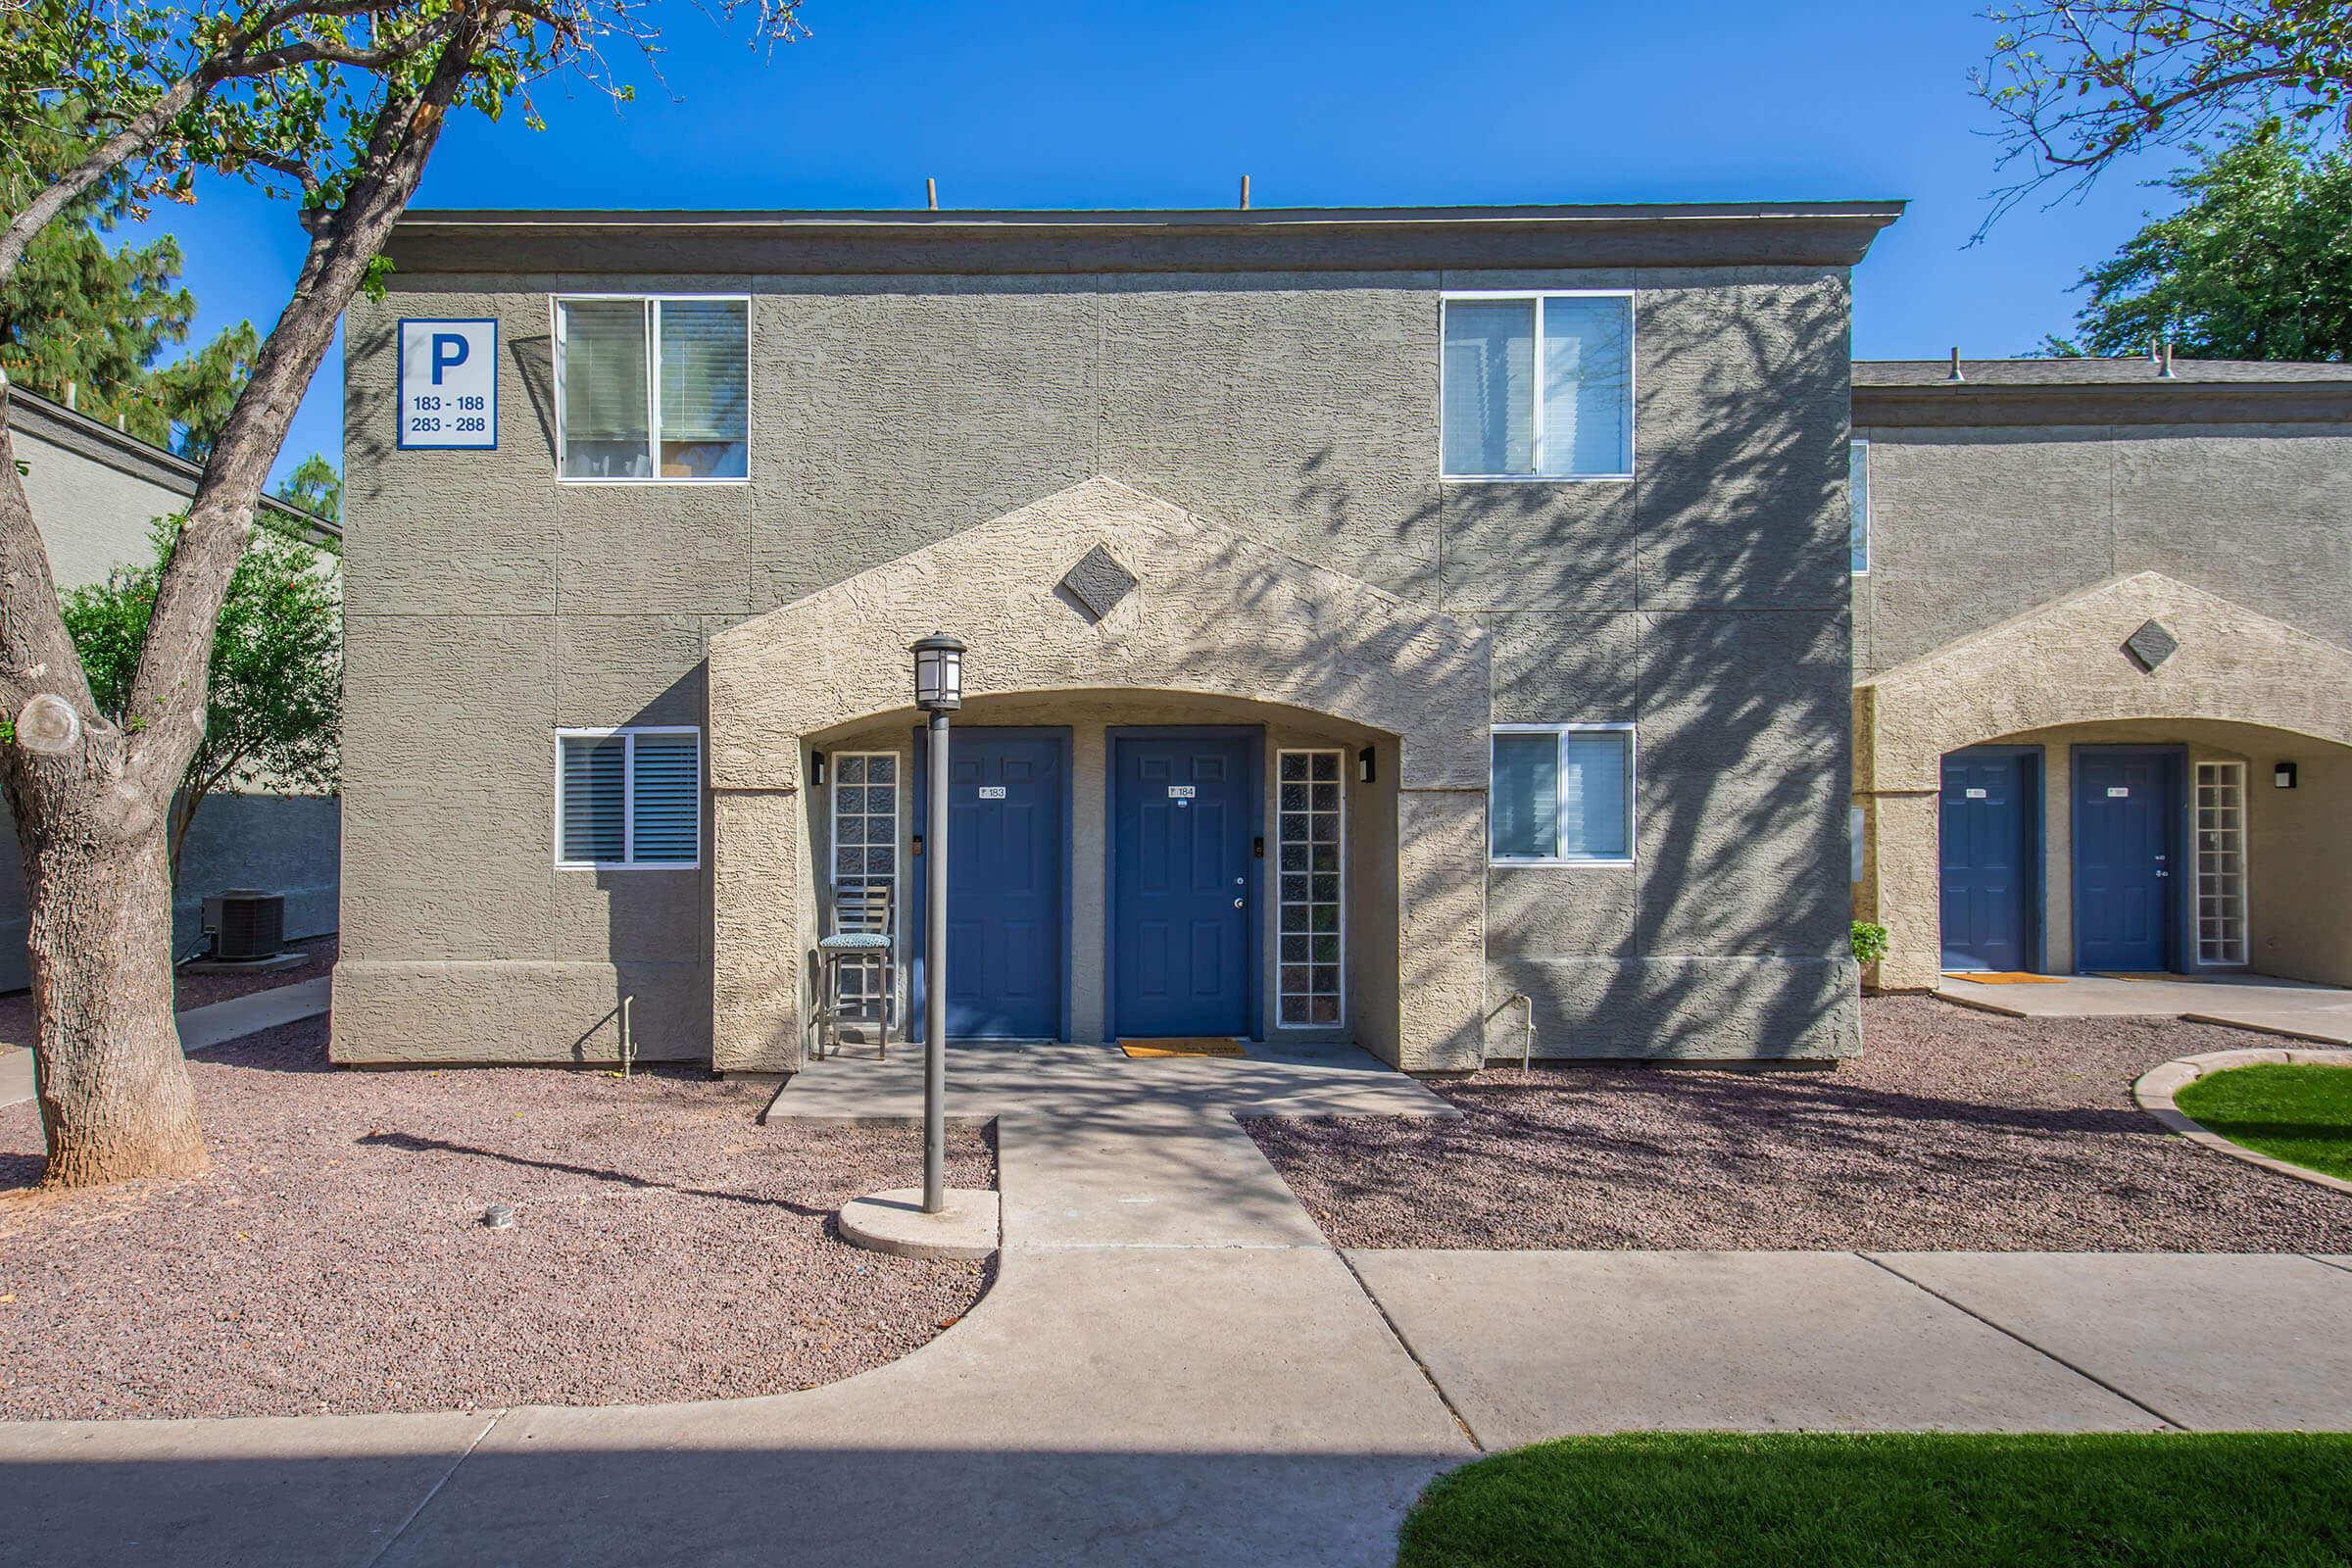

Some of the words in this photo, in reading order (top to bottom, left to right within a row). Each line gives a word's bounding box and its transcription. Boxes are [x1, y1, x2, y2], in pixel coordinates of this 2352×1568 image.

[432, 333, 469, 385] P
[414, 396, 441, 411] 183
[457, 396, 484, 411] 188
[412, 417, 441, 431] 283
[456, 417, 485, 431] 288
[989, 788, 1004, 797] 183
